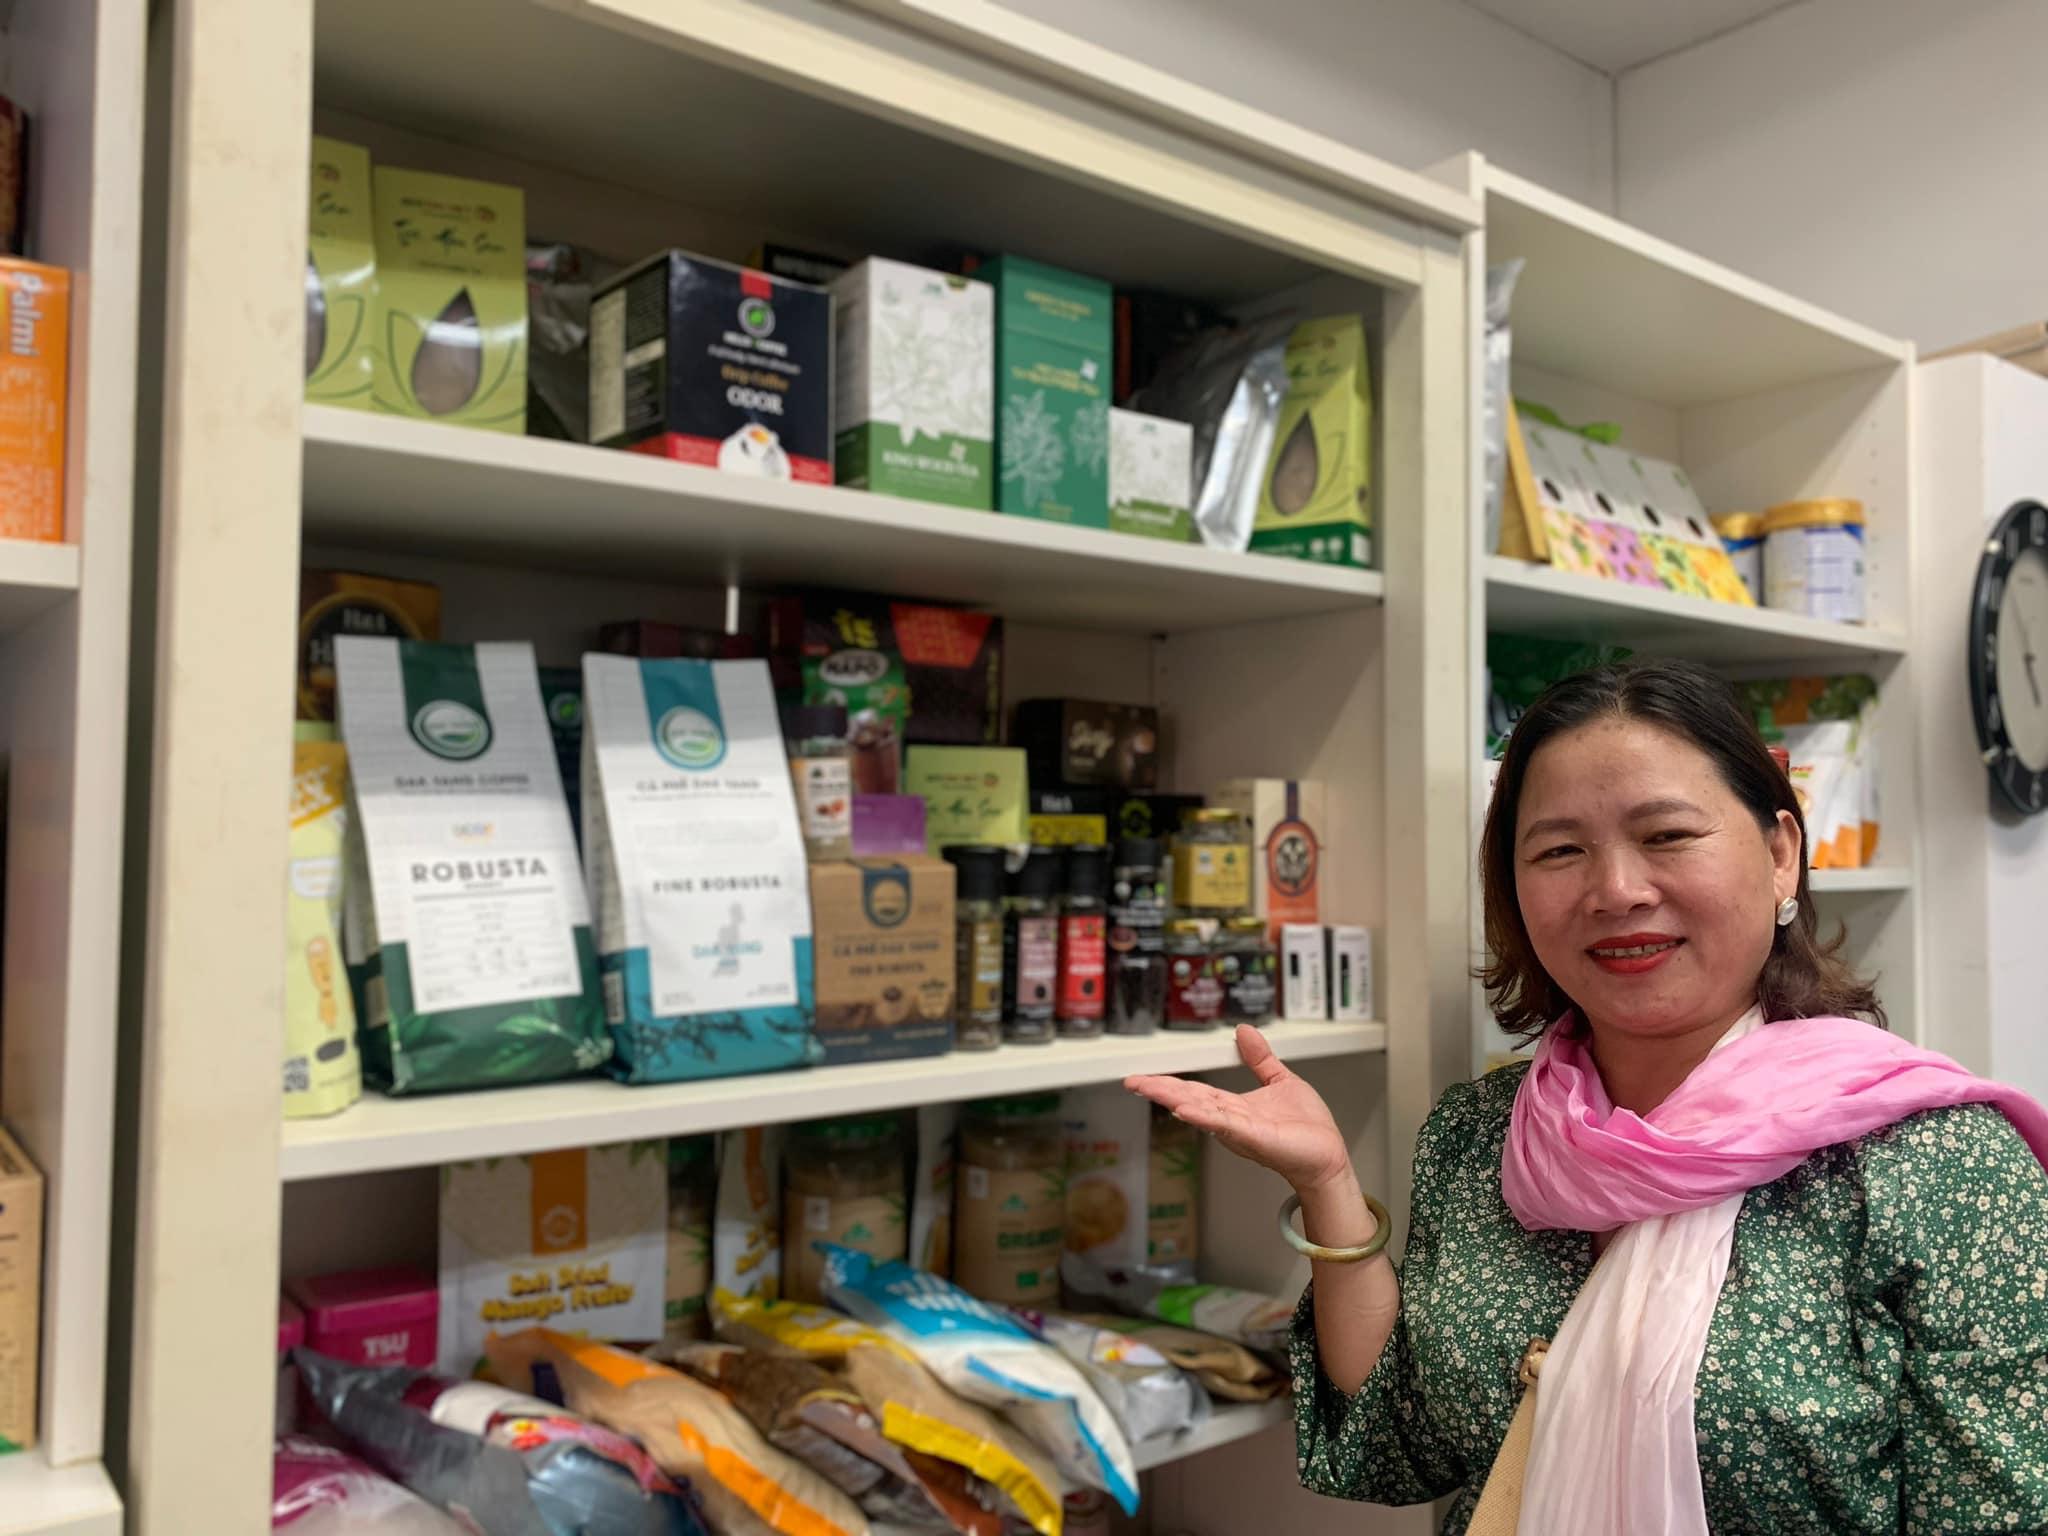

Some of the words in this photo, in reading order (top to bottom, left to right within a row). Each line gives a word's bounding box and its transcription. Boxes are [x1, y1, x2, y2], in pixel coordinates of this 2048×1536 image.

[11, 271, 42, 355] Palmi
[726, 384, 784, 416] ODOR
[411, 857, 548, 884] ROBUSTA
[653, 878, 693, 894] FINE
[700, 874, 781, 892] ROBUSTA
